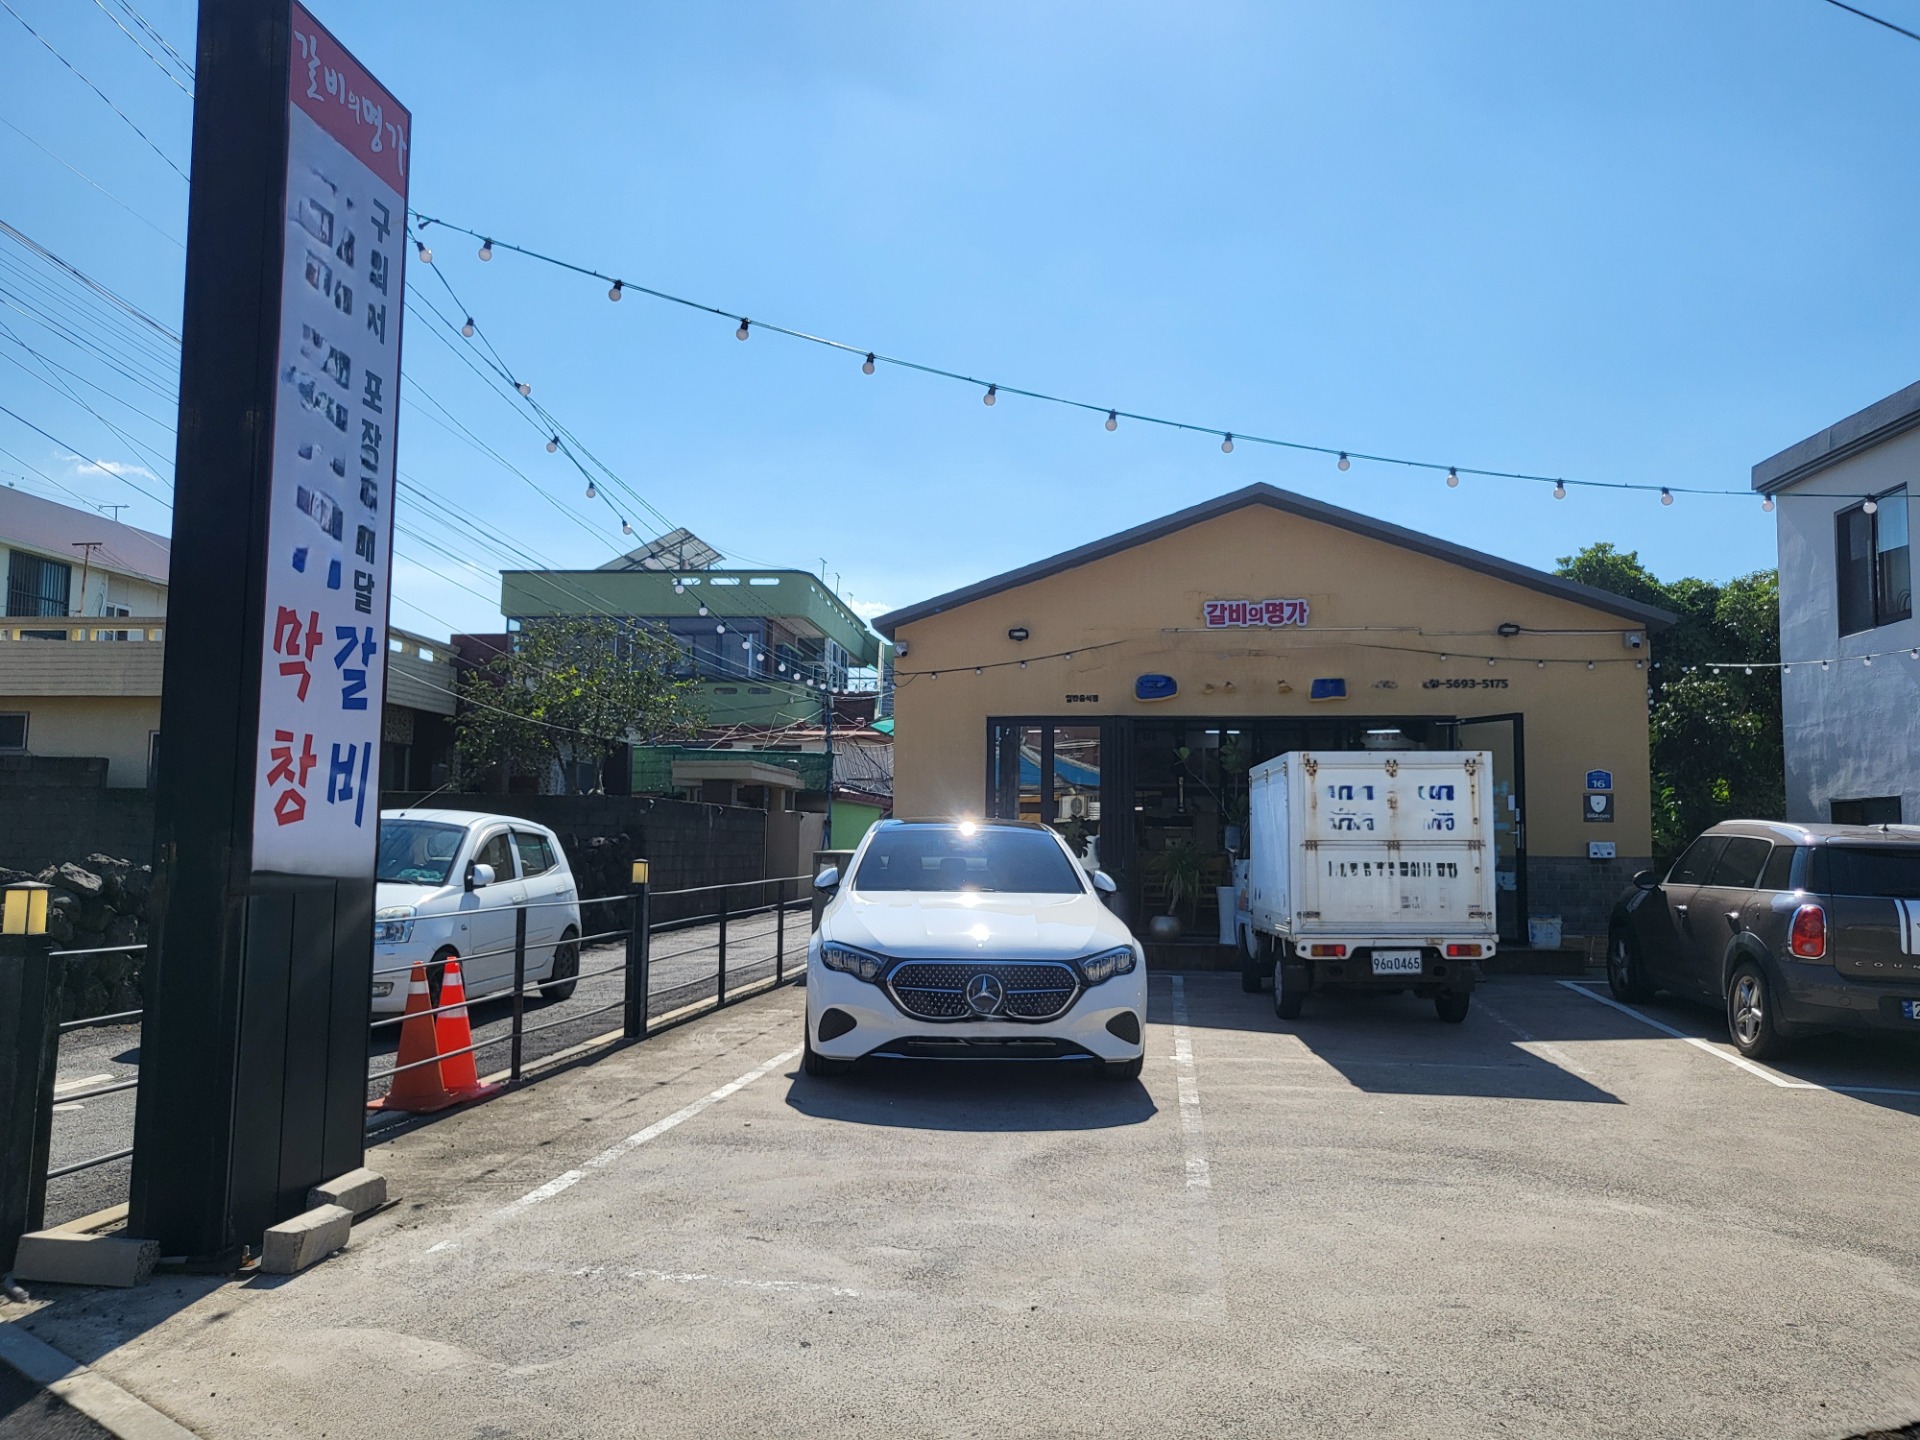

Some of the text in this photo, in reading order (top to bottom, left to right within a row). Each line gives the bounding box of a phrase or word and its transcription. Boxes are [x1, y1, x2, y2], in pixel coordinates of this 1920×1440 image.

[294, 30, 407, 177] 갈비의명가
[1205, 600, 1307, 626] 갈비의명가
[267, 605, 323, 827] 막창
[327, 625, 377, 828] 갈비
[1592, 780, 1606, 789] 16
